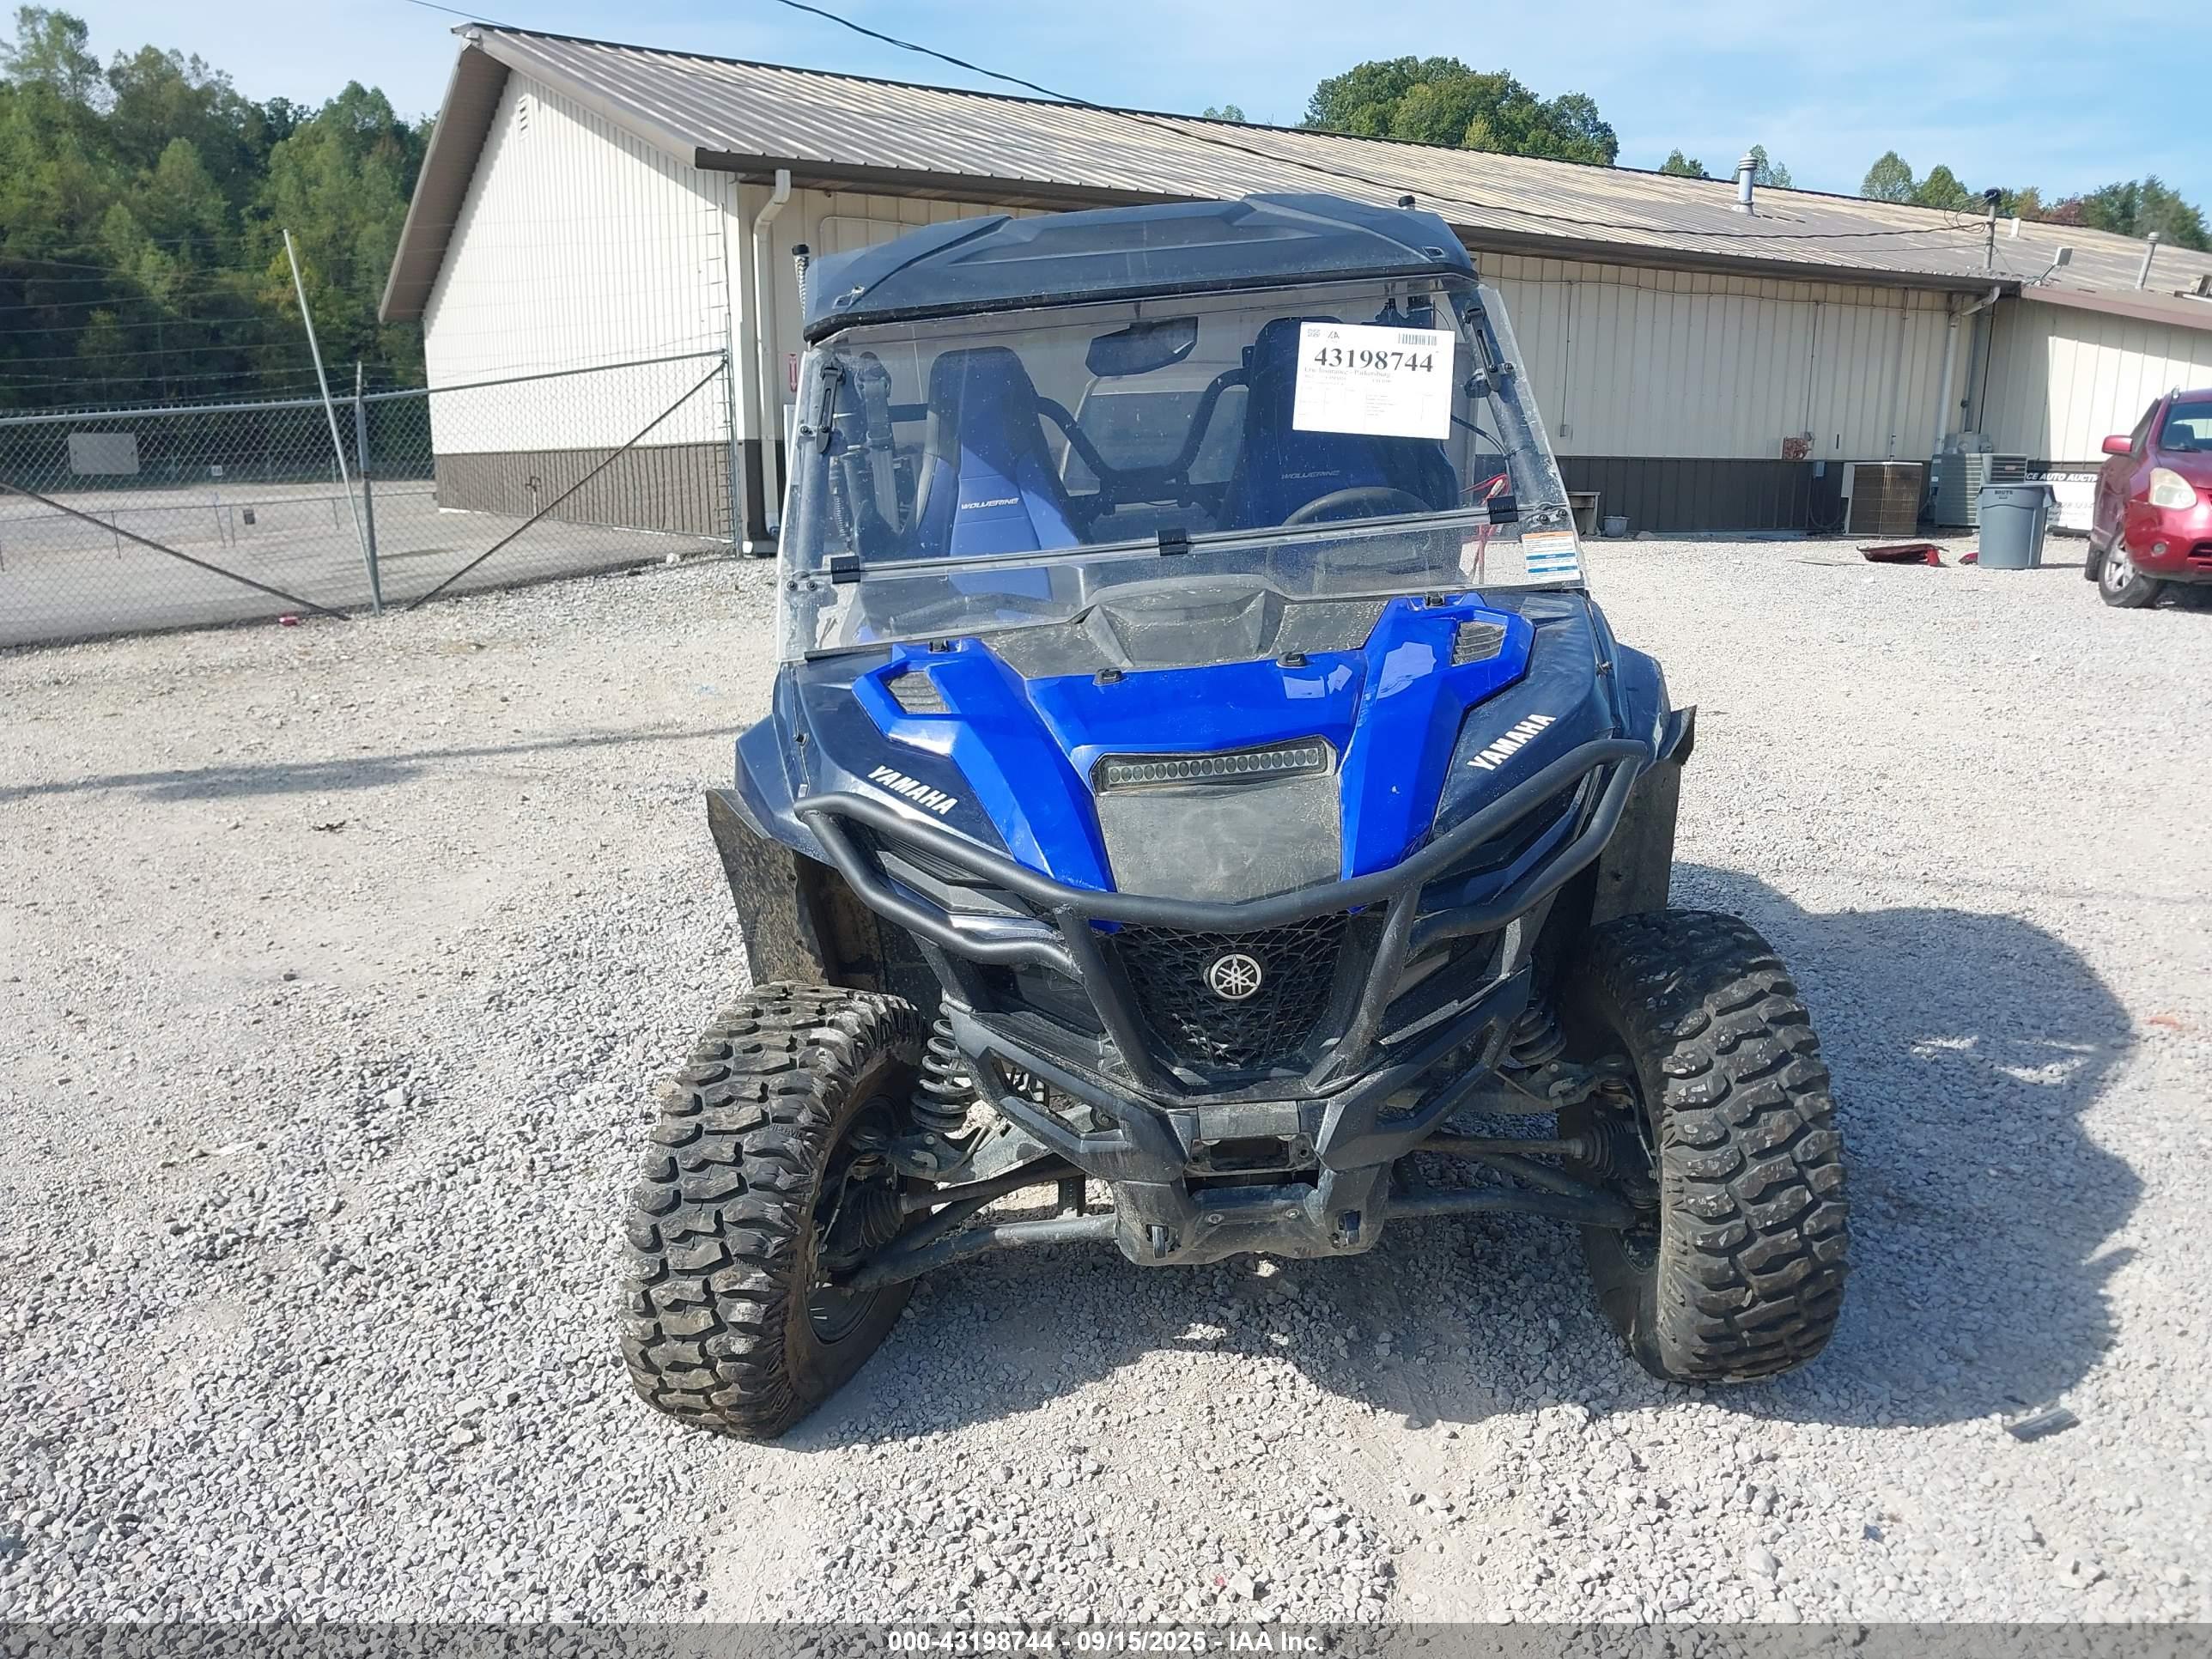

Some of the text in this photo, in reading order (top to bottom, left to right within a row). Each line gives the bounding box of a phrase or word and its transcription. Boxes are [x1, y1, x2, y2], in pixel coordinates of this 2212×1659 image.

[1315, 347, 1433, 372] 43198744
[2039, 472, 2066, 481] AUTO
[962, 498, 1019, 509] WOLVERINE
[1467, 714, 1557, 770] YAMAHA
[867, 765, 958, 815] YAMAHA
